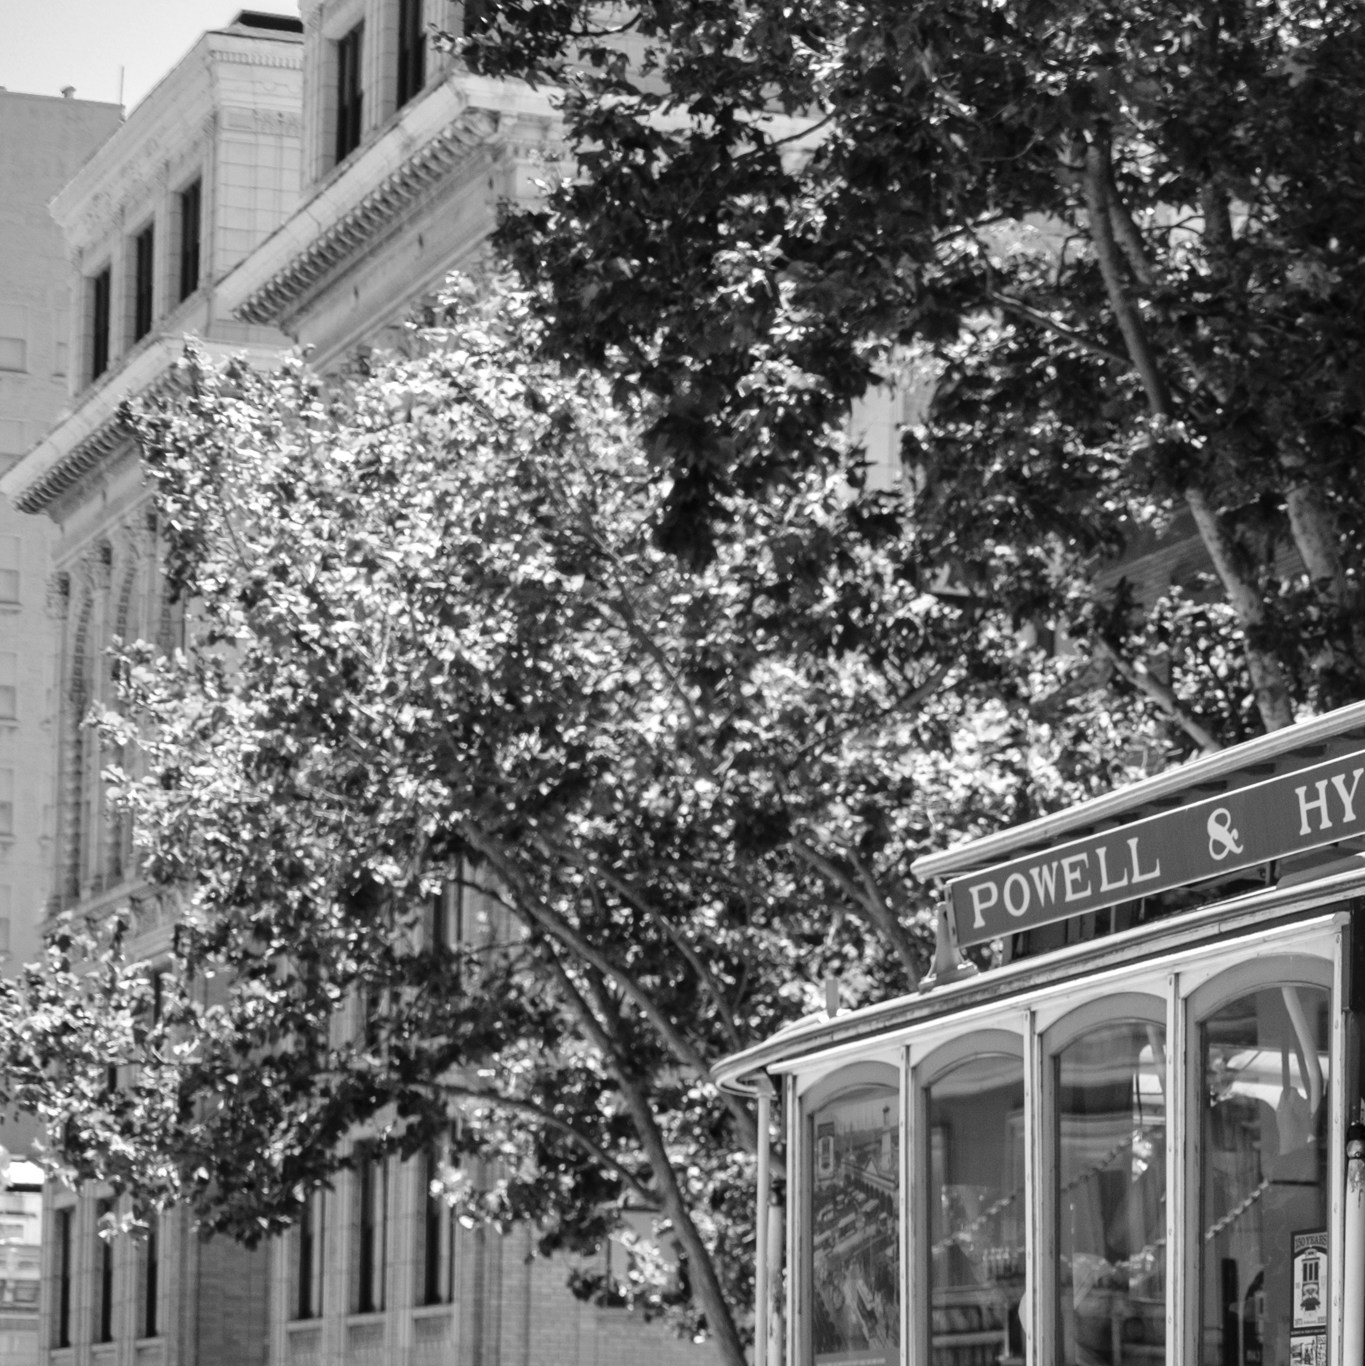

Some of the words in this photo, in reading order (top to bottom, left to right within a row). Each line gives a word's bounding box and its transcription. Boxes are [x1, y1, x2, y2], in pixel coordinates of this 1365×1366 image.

[968, 837, 1161, 930] POWELL
[1207, 807, 1244, 861] &
[1306, 1234, 1327, 1247] YEARS
